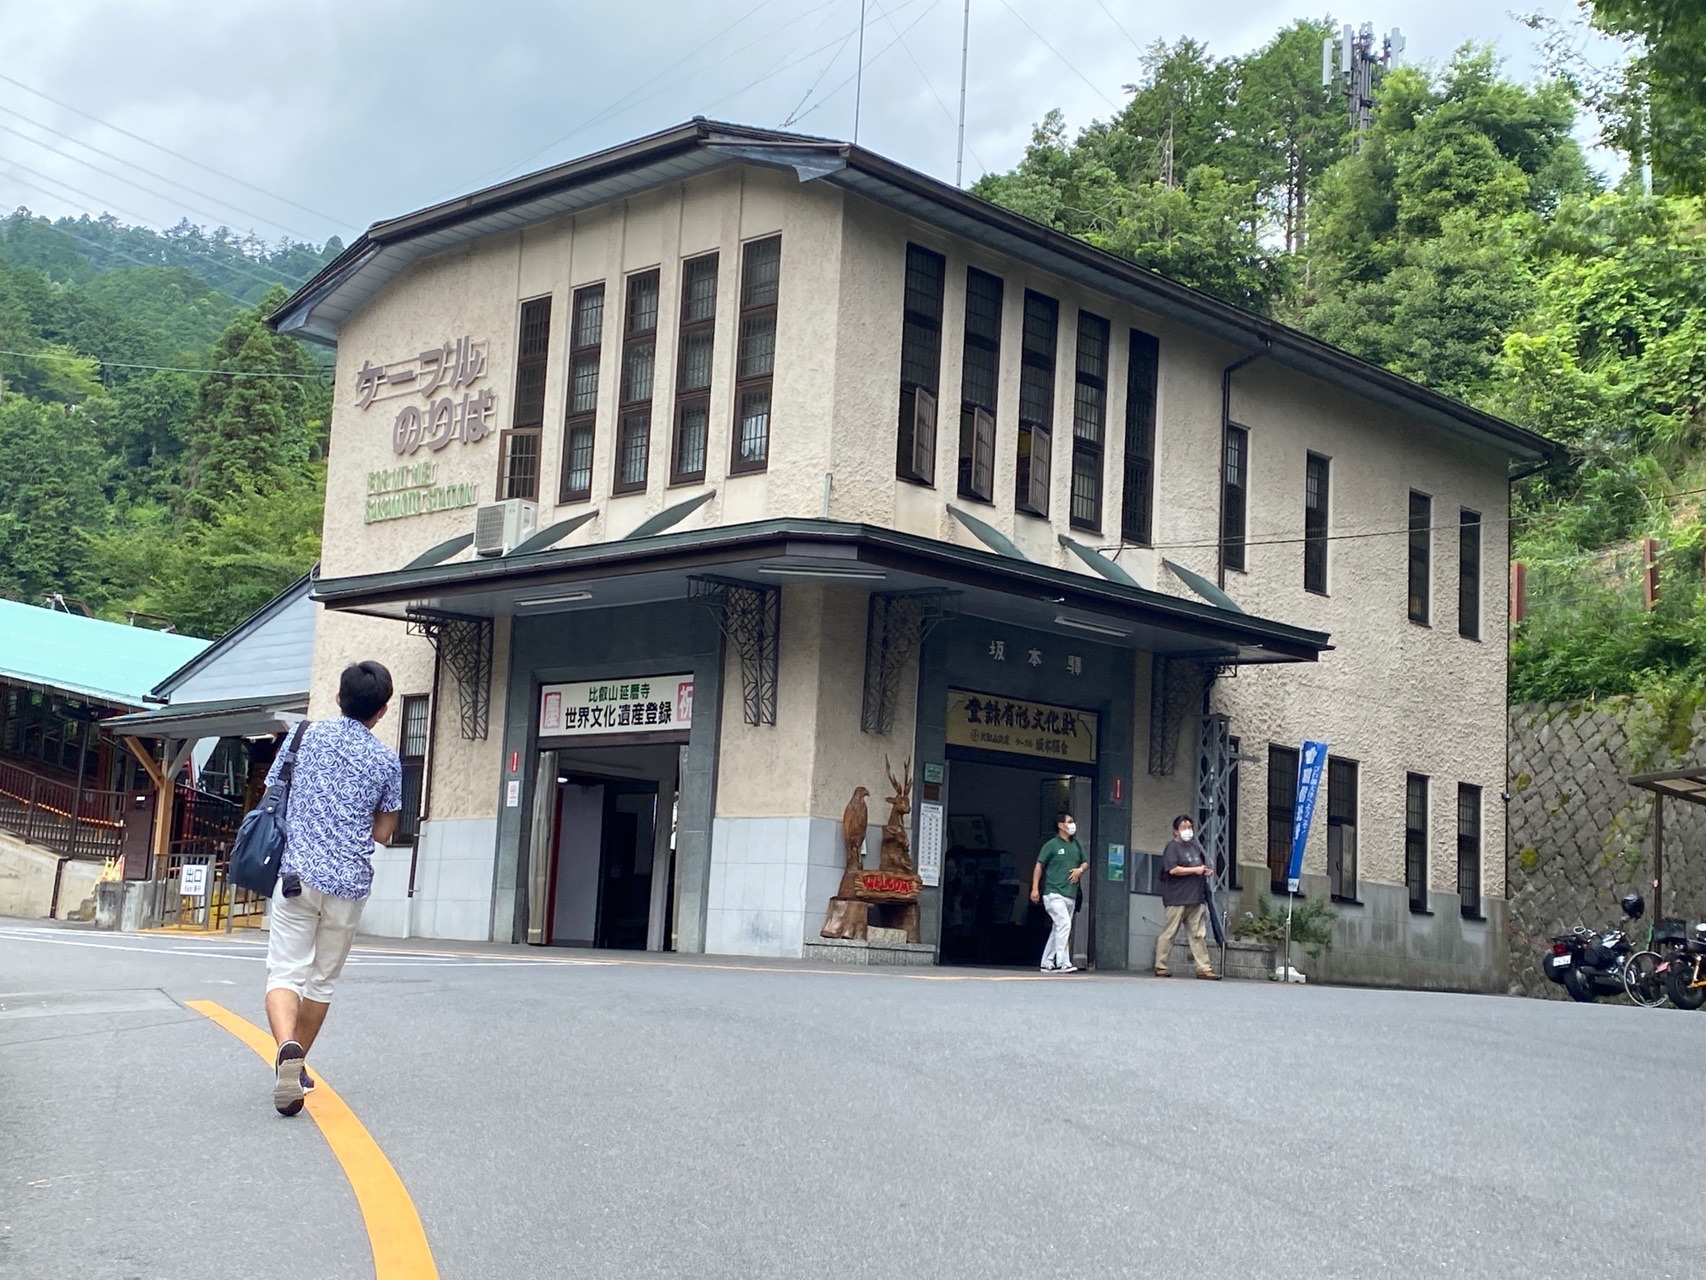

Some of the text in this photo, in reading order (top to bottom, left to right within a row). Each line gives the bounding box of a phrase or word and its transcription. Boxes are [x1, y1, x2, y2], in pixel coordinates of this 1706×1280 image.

[355, 335, 482, 410] ケーブル
[393, 388, 494, 454] のりば
[365, 482, 478, 523] SAKAMOTO STATION
[588, 683, 650, 702] 比叡山延暦寺
[565, 701, 672, 730] 世界文化遺産登録
[185, 867, 203, 883] 出口
